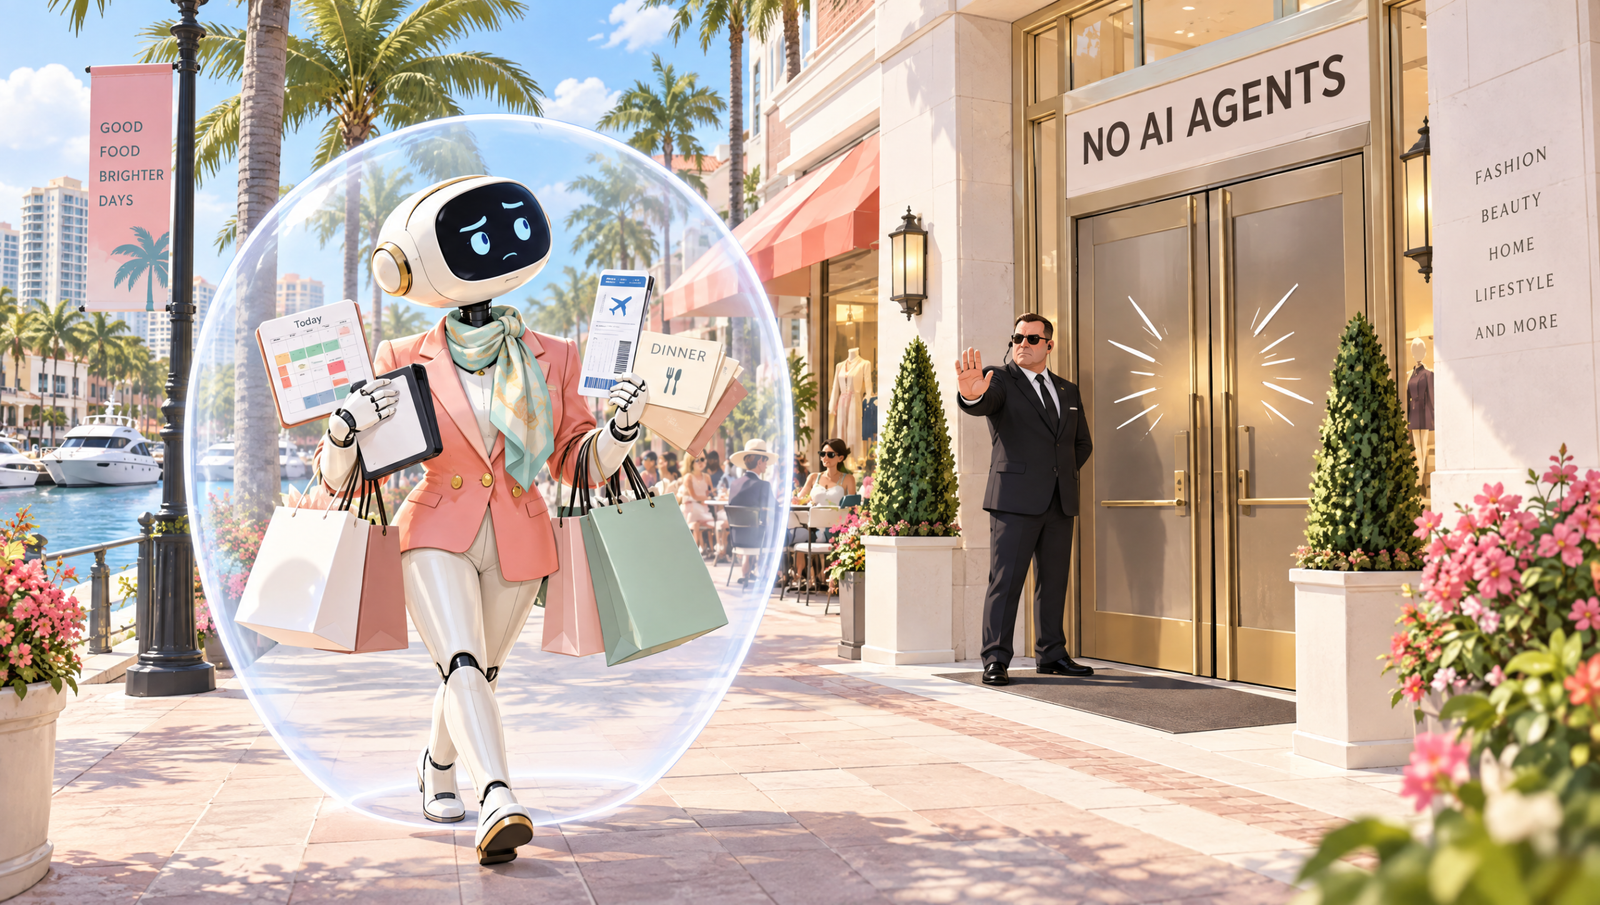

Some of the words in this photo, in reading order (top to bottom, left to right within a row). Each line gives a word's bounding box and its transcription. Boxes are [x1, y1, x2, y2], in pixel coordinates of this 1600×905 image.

[1083, 120, 1131, 166] NO
[1140, 106, 1173, 151] AI
[1187, 54, 1346, 138] AGENTS
[100, 121, 143, 134] GOOD
[100, 145, 140, 158] FOOD
[99, 169, 164, 182] BRIGHTER
[1475, 146, 1547, 185] FASHION
[99, 194, 134, 207] DAYS
[1481, 191, 1541, 223] BEAUTY
[1489, 236, 1535, 261] HOME
[1475, 272, 1555, 303] LIFESTYLE
[293, 315, 322, 329] Today
[1475, 322, 1506, 340] AND
[1513, 313, 1558, 334] MORE
[650, 342, 707, 362] DINNER
